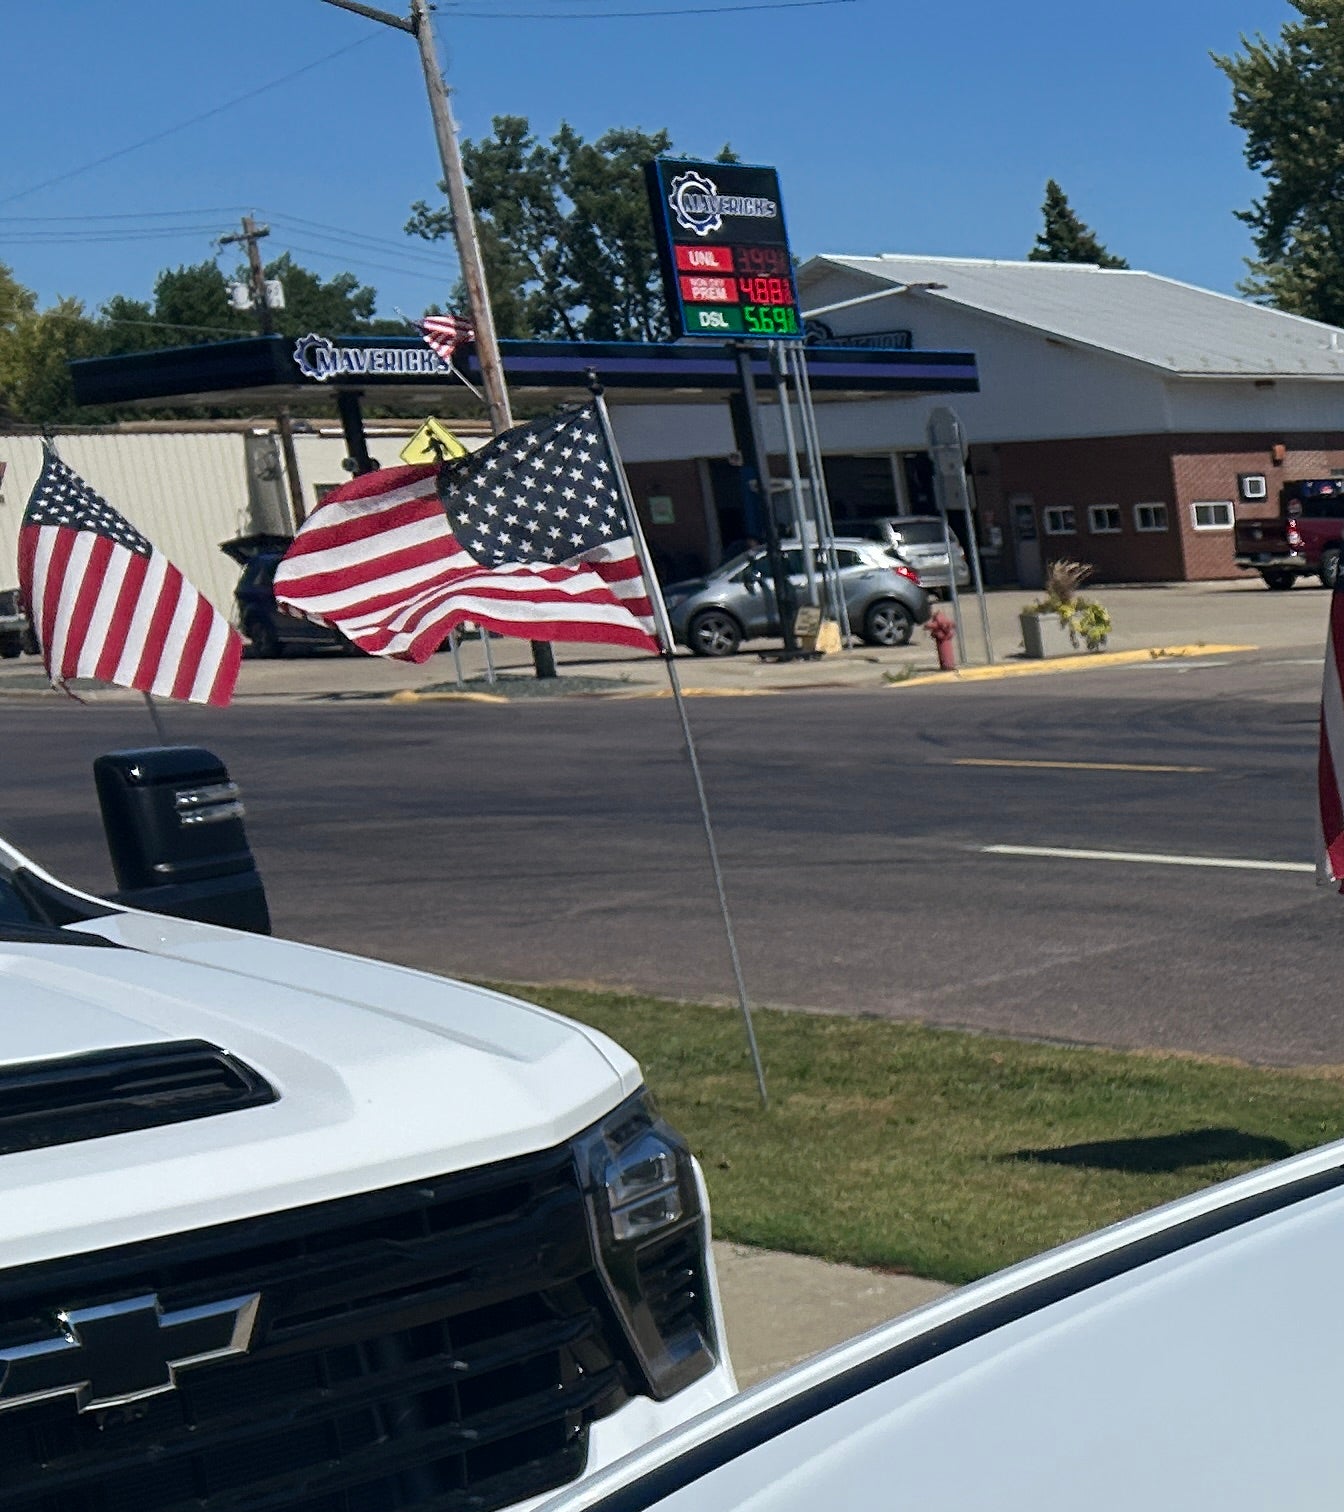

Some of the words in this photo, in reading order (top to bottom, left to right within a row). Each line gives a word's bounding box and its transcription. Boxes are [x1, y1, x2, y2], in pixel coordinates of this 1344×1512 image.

[688, 250, 719, 267] UNL
[691, 287, 728, 300] PREM
[698, 311, 729, 328] DSL
